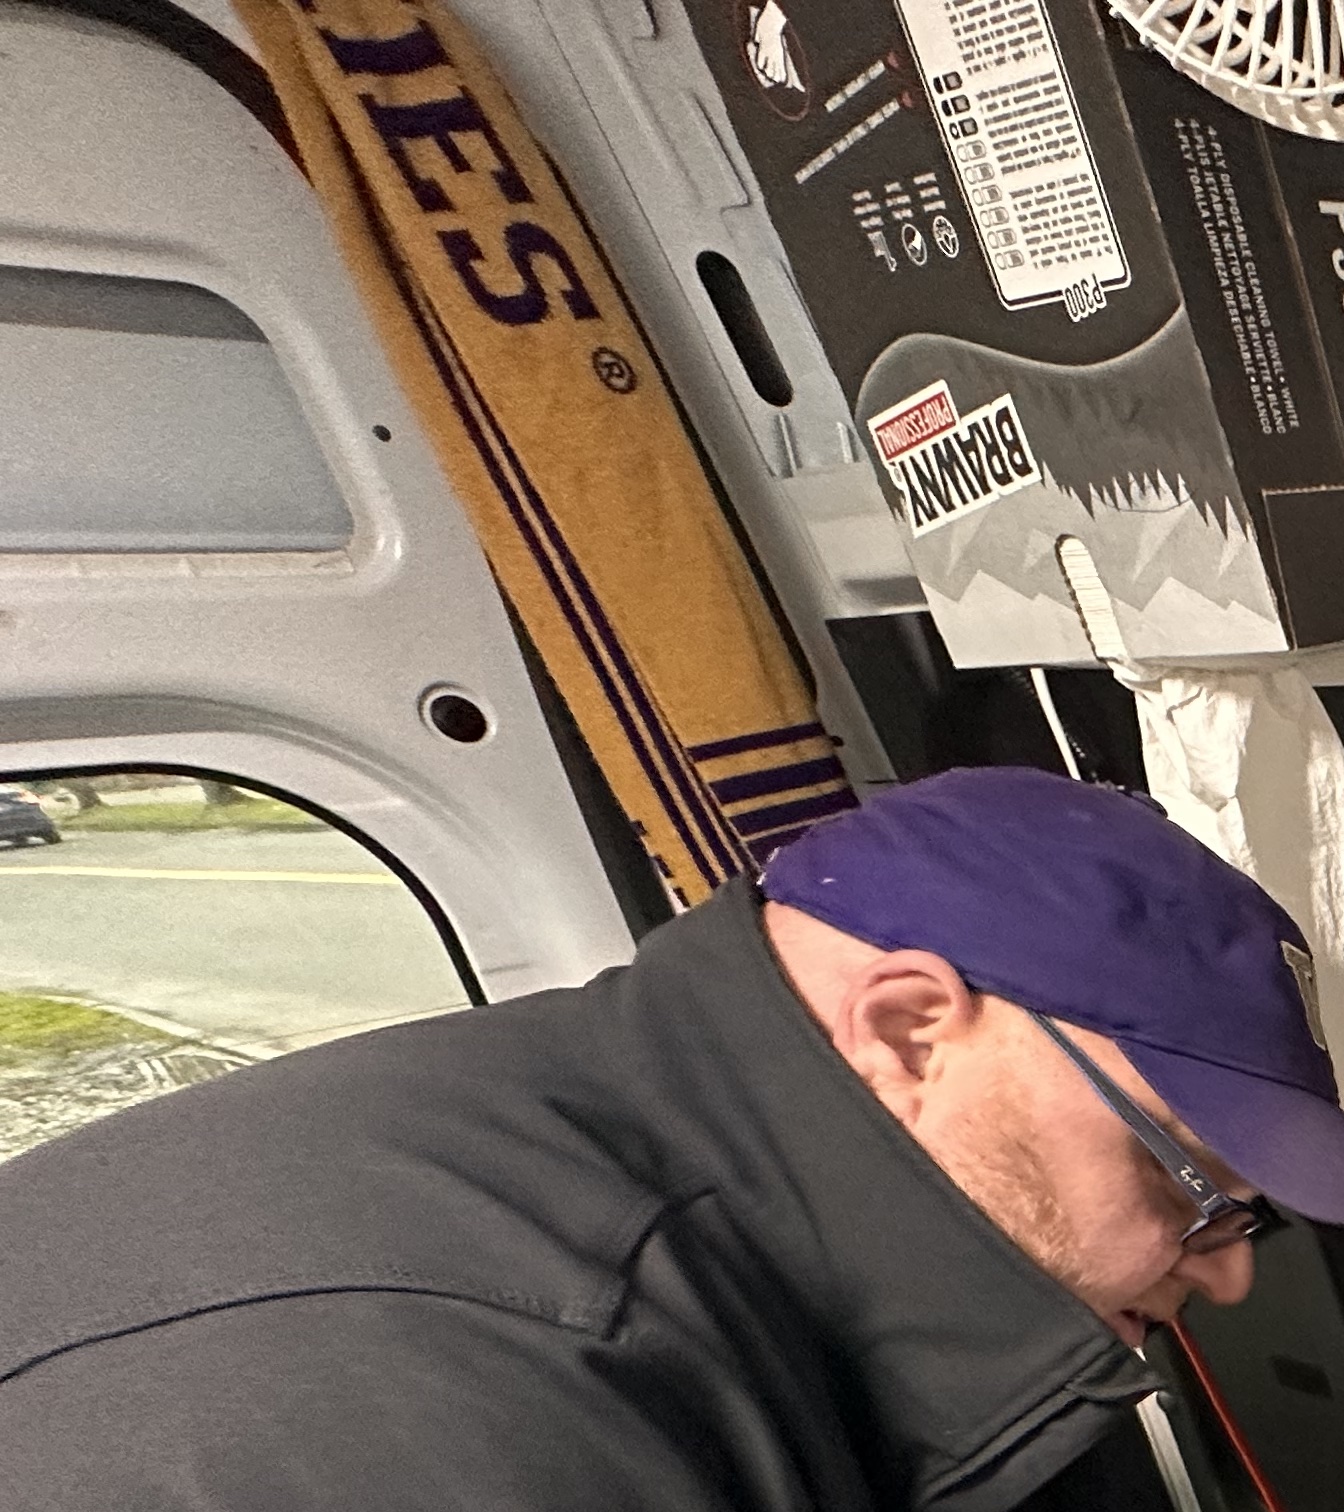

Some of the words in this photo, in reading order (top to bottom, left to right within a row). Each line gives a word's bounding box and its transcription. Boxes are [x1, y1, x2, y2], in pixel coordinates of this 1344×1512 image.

[303, 0, 603, 328] IES
[1220, 173, 1254, 258] DISPOSABLE
[1245, 261, 1272, 328] CLEANING
[1265, 331, 1286, 375] TOWEL
[1281, 386, 1300, 428] WHITE
[876, 394, 953, 456] PROFESSIONAL
[1244, 315, 1273, 383] SERVIETTE
[1267, 393, 1287, 434] BLANC
[1250, 384, 1273, 435] BLANCO
[899, 405, 1034, 528] BRAWNY
